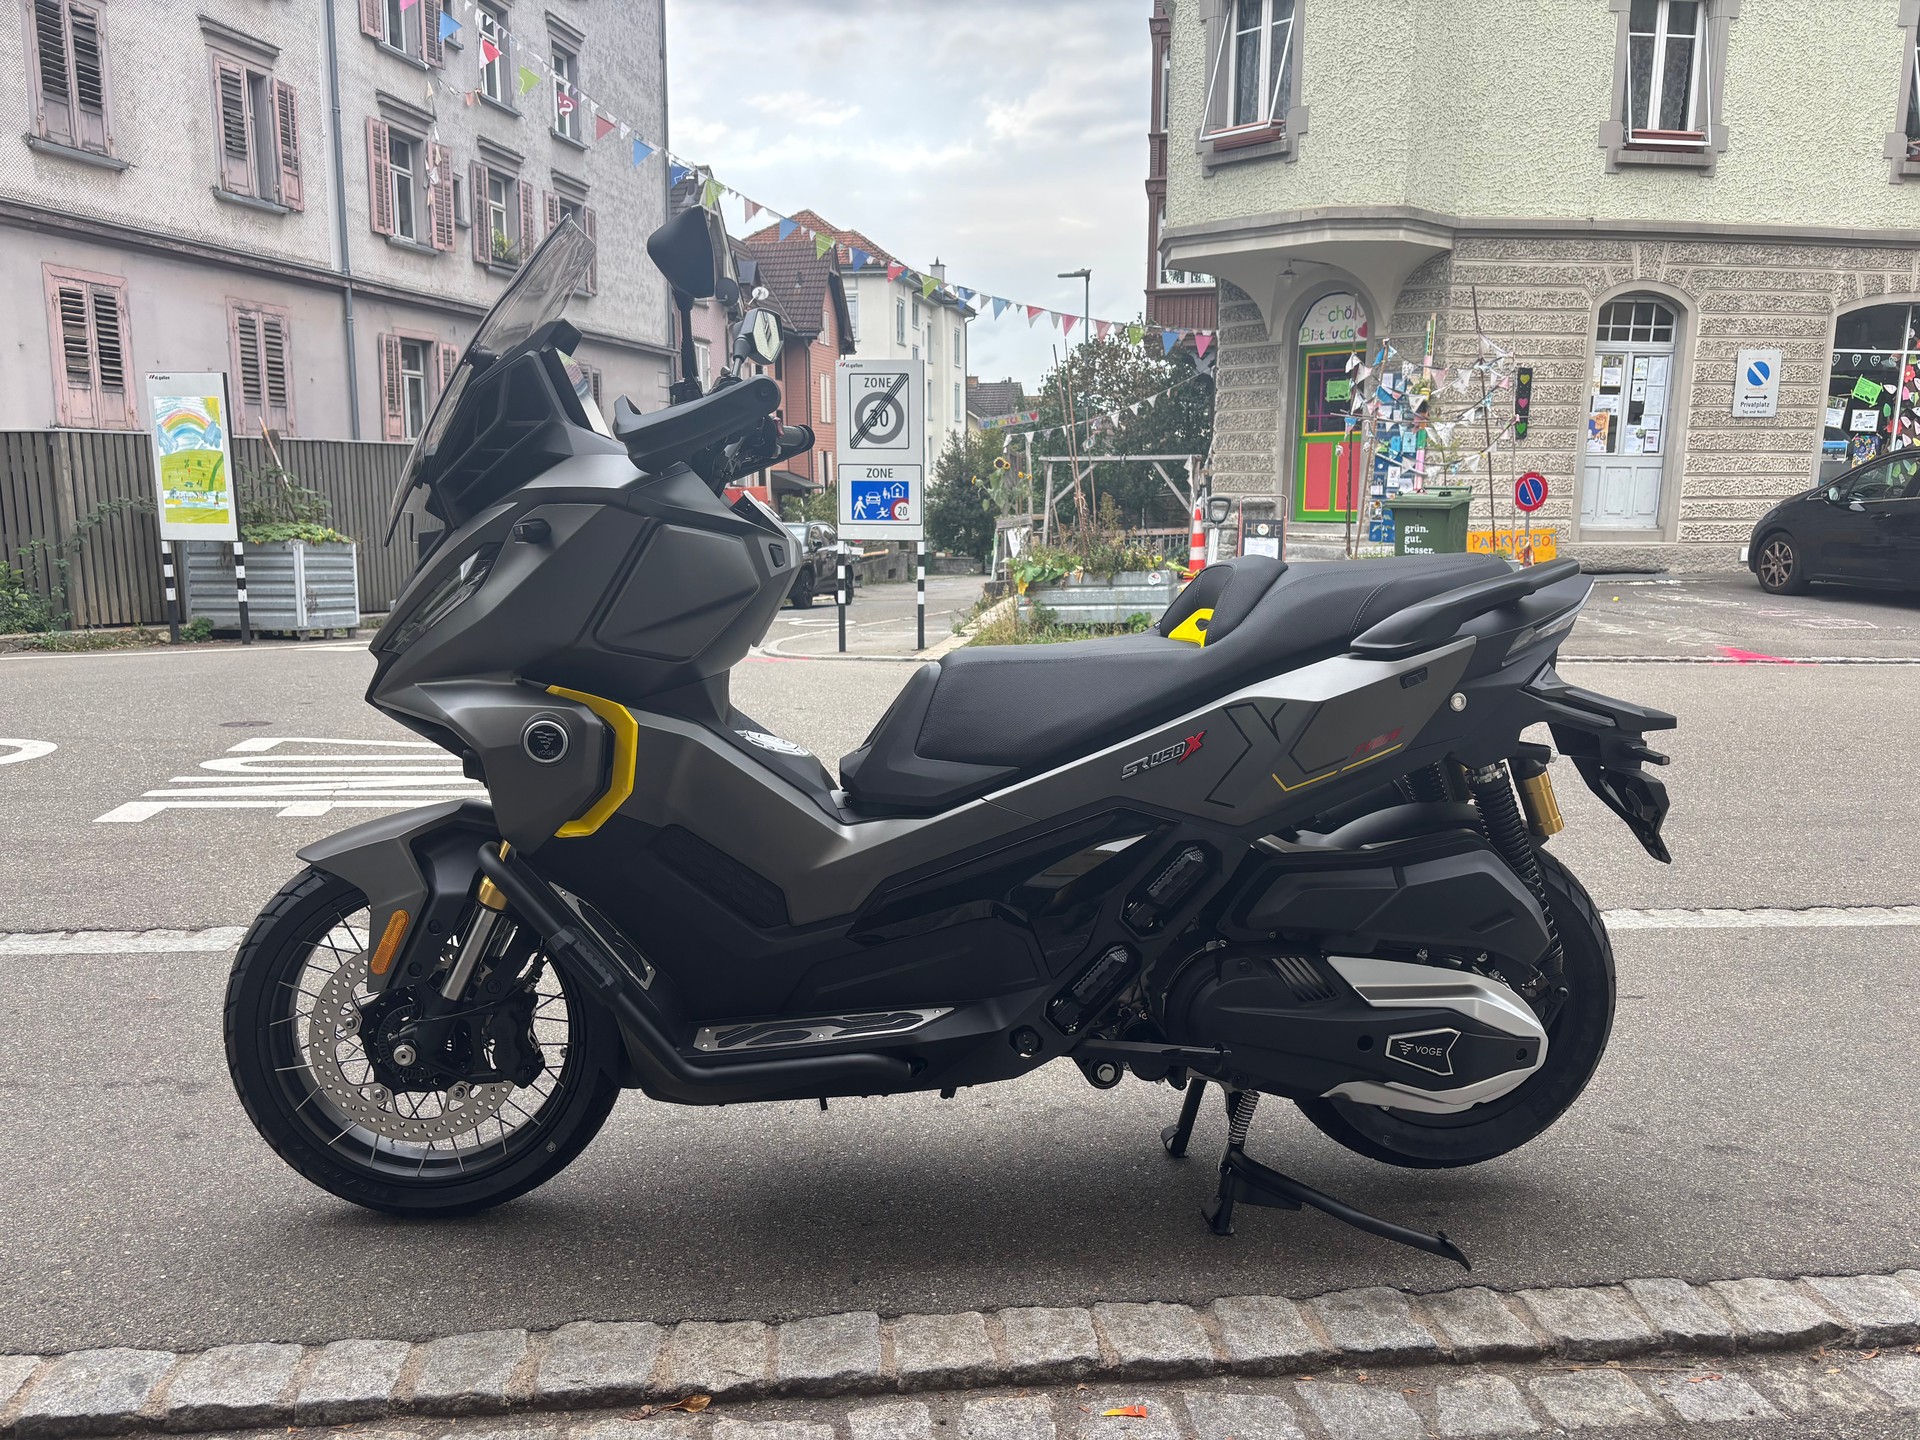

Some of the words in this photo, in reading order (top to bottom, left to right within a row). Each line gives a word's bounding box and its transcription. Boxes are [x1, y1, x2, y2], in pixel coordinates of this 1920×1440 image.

[864, 377, 892, 388] ZONE
[1740, 401, 1770, 409] Privatplatz
[869, 408, 889, 428] 30
[866, 467, 894, 479] ZONE
[897, 505, 908, 516] 20
[1245, 522, 1281, 537] HETE
[1404, 524, 1429, 534] grün.
[1404, 535, 1422, 544] gut.
[1404, 545, 1435, 554] besser.
[1415, 1045, 1443, 1056] VOGE
